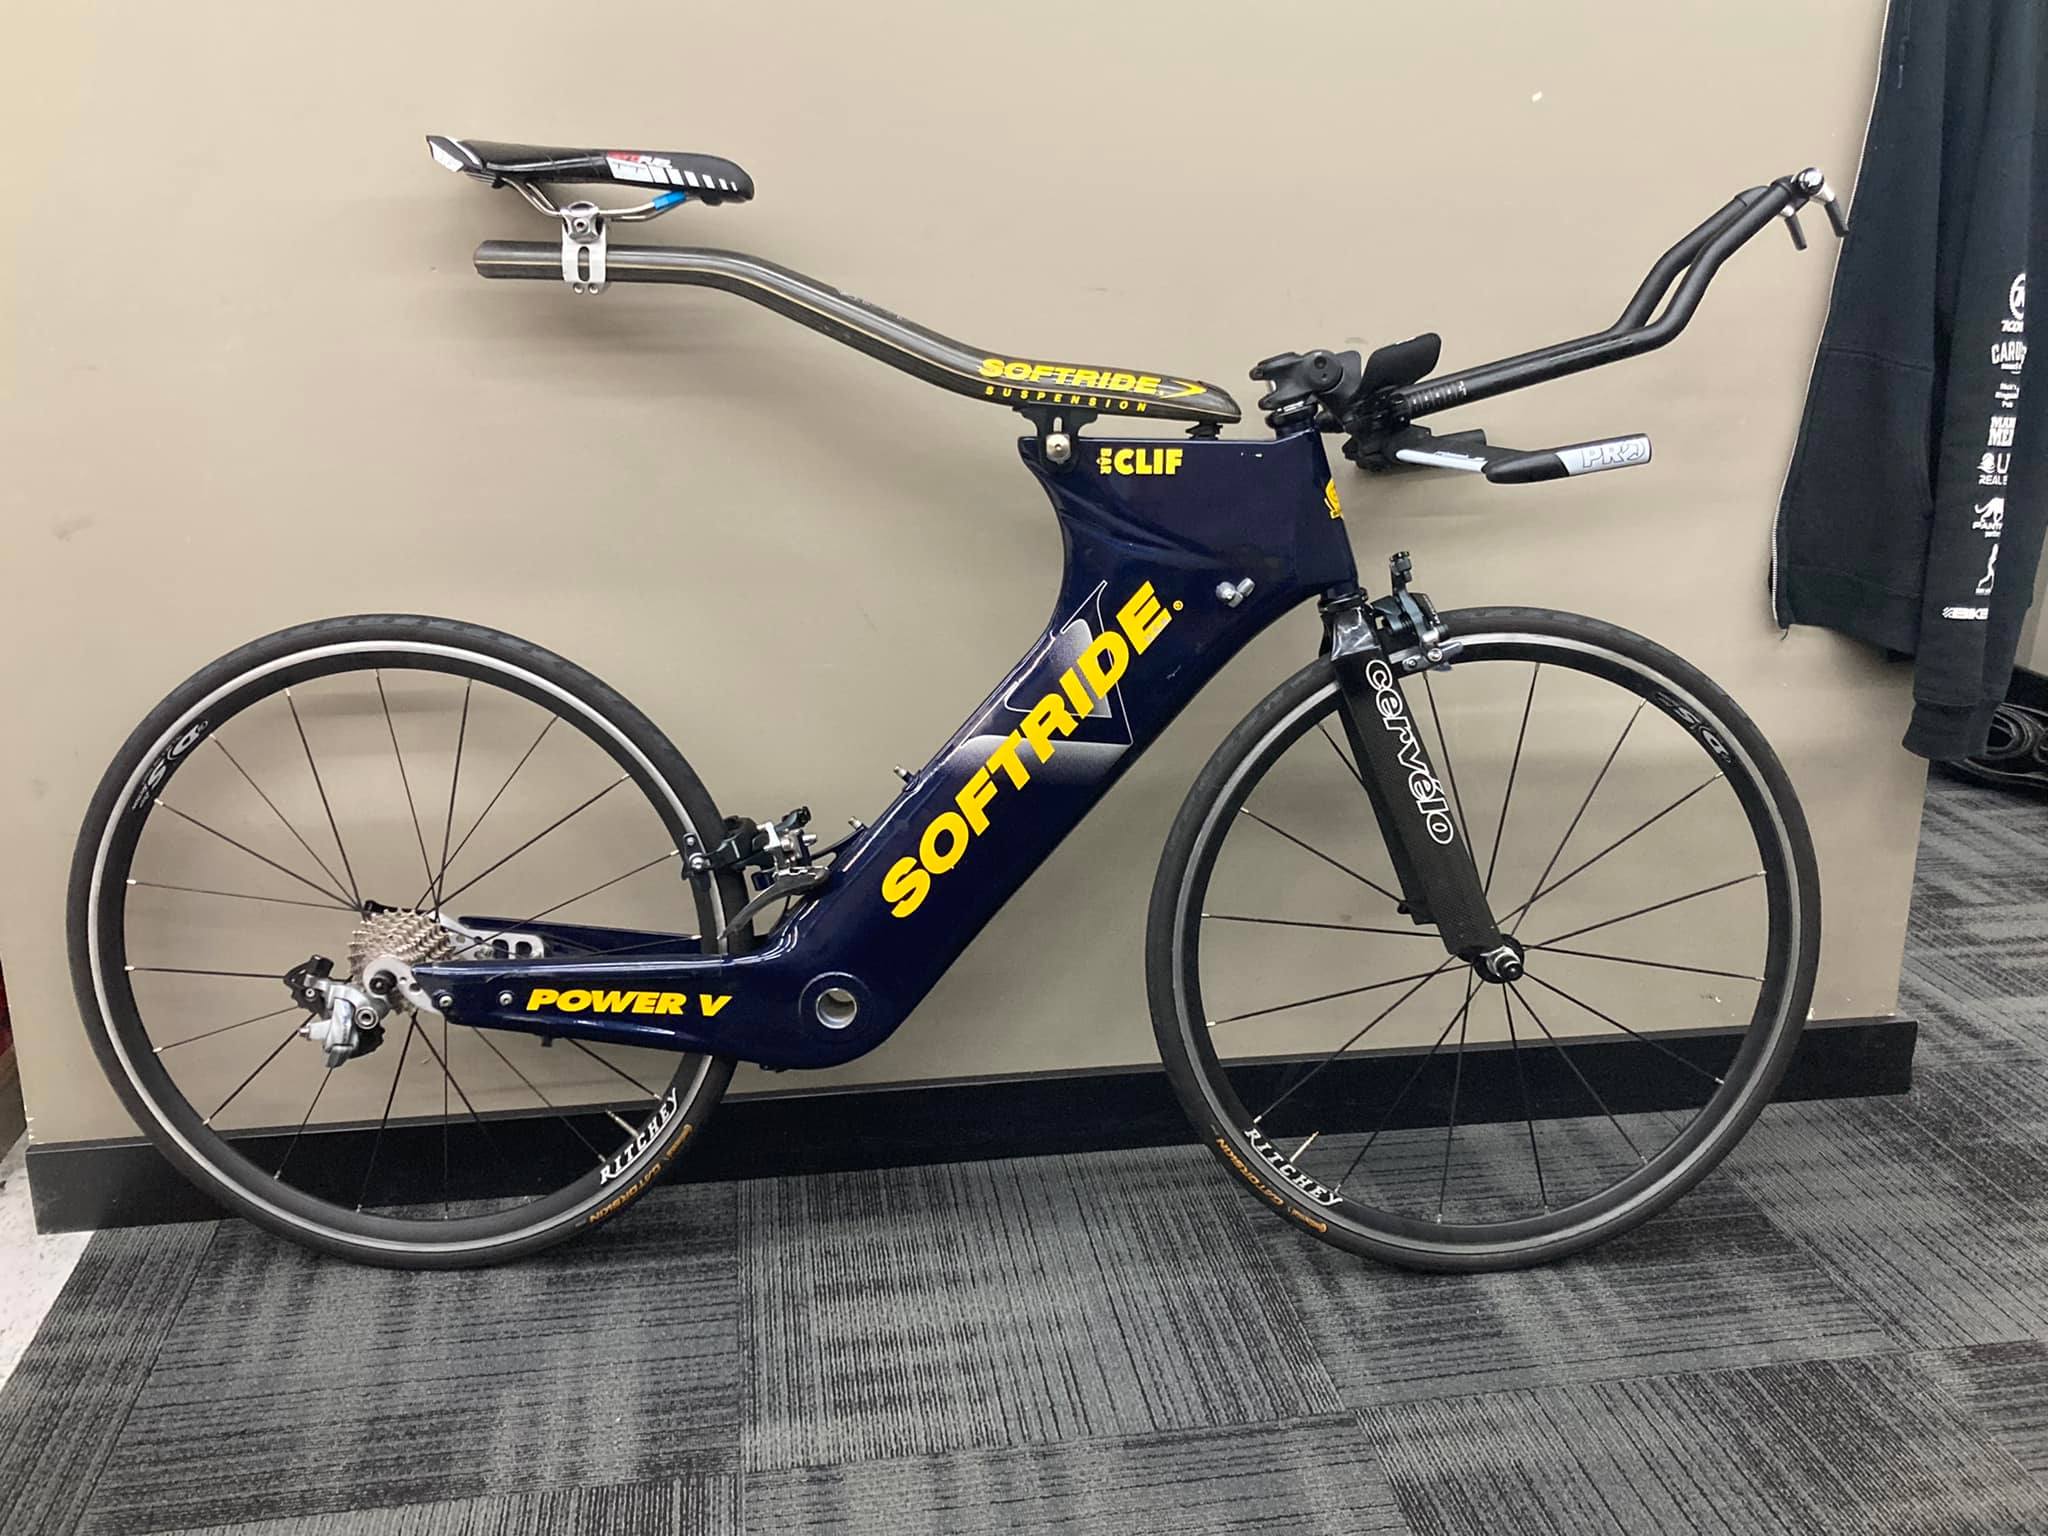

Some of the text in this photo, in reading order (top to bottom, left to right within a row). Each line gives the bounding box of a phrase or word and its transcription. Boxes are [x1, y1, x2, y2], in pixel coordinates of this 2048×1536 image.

[977, 359, 1163, 394] SOFTRIDE
[985, 385, 1148, 412] SUSPENSION
[1114, 448, 1183, 475] CLIF
[1582, 441, 1645, 468] PRO
[881, 581, 1173, 918] SOFTRIDE
[526, 988, 733, 1017] POWER V
[600, 1087, 677, 1185] RITCHEY
[1244, 1128, 1343, 1207] RITCHEY
